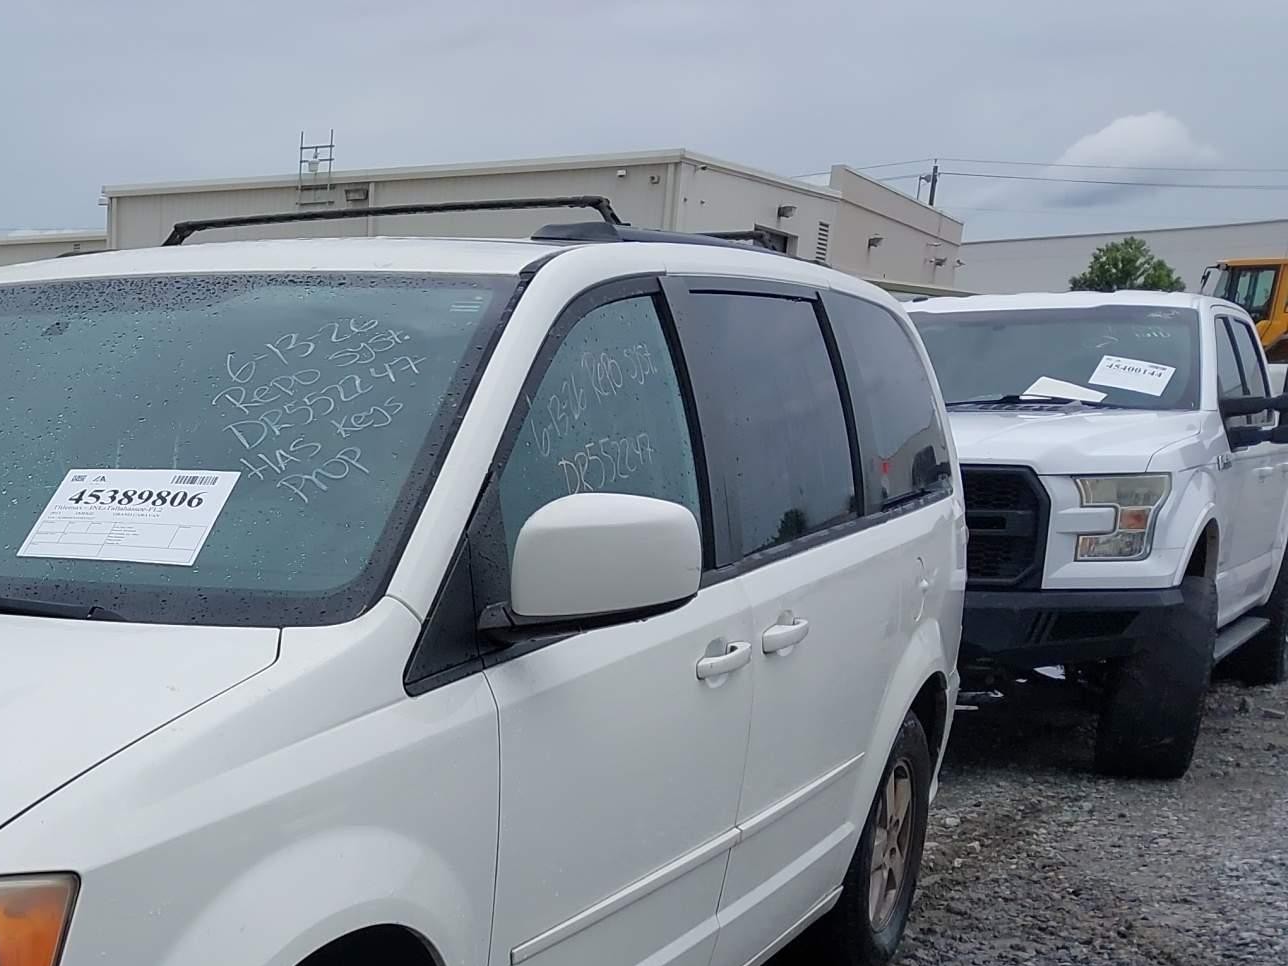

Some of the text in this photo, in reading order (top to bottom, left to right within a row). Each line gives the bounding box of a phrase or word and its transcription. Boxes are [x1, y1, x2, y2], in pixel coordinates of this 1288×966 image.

[227, 318, 378, 383] 6-13-26
[240, 438, 322, 480] HAS
[68, 488, 209, 509] 45389806
